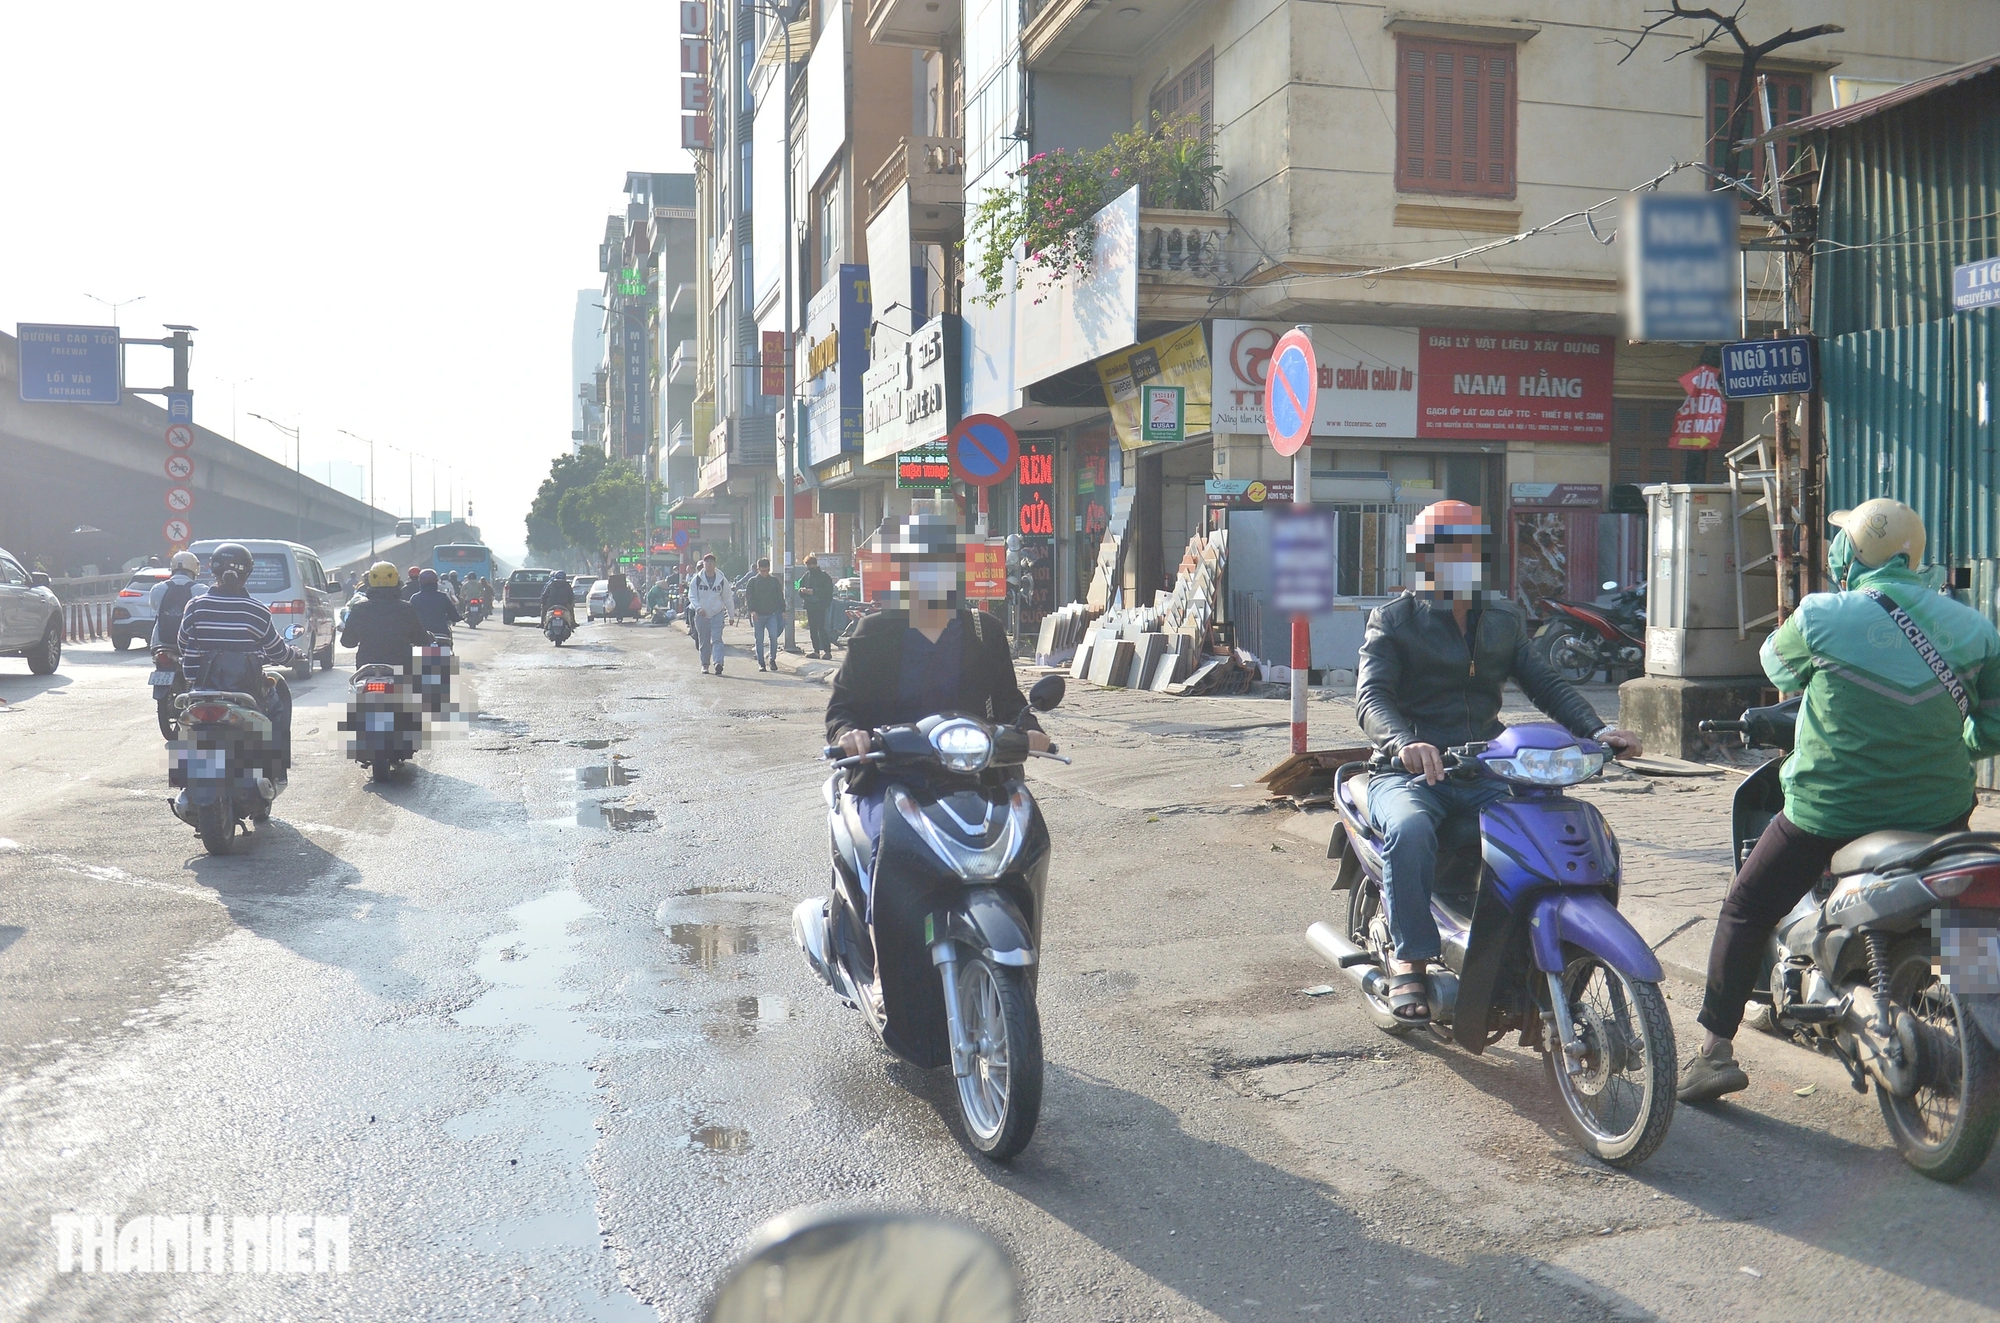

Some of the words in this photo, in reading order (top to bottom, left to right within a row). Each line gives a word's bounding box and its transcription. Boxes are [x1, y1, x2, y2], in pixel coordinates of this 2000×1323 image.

[22, 330, 60, 344] ĐƯỜNG
[66, 334, 88, 344] CAO
[94, 332, 114, 344] TỐC
[1429, 335, 1451, 350] ĐẠI
[1456, 334, 1468, 348] LÝ
[1475, 336, 1497, 351] VẬT
[1502, 337, 1528, 352] LIỆU
[1534, 338, 1558, 352] XÂY
[51, 346, 88, 356] FREEWAY
[1730, 344, 1766, 371] NGÕ
[1770, 346, 1802, 368] 116
[46, 370, 64, 383] LỐI
[72, 372, 92, 384] VÀO
[1336, 360, 1368, 390] CHUẨN
[1372, 366, 1397, 391] CHÂU
[1399, 366, 1413, 391] ÂU
[1454, 374, 1506, 396] NAM
[1519, 368, 1582, 398] HẰNG
[1730, 370, 1777, 389] NGUYỄN
[1780, 368, 1806, 385] XIỂN
[49, 387, 91, 396] ENTRANCE
[1426, 408, 1448, 416] GẠCH
[1450, 406, 1460, 416] ỐP
[1463, 407, 1477, 416] LÁT
[1498, 407, 1513, 417] CẤP
[1541, 409, 1561, 419] THIẾT
[1564, 411, 1572, 420] BỊ
[1574, 411, 1584, 420] VỆ
[1586, 412, 1604, 420] SINH
[1675, 420, 1693, 433] XE
[1693, 416, 1721, 433] MÁY
[901, 463, 922, 480] ĐIỆN
[922, 465, 948, 480] THOẠI
[1020, 444, 1052, 484] RÈM
[1020, 492, 1053, 534] CỬA
[1867, 621, 1954, 650] Grb
